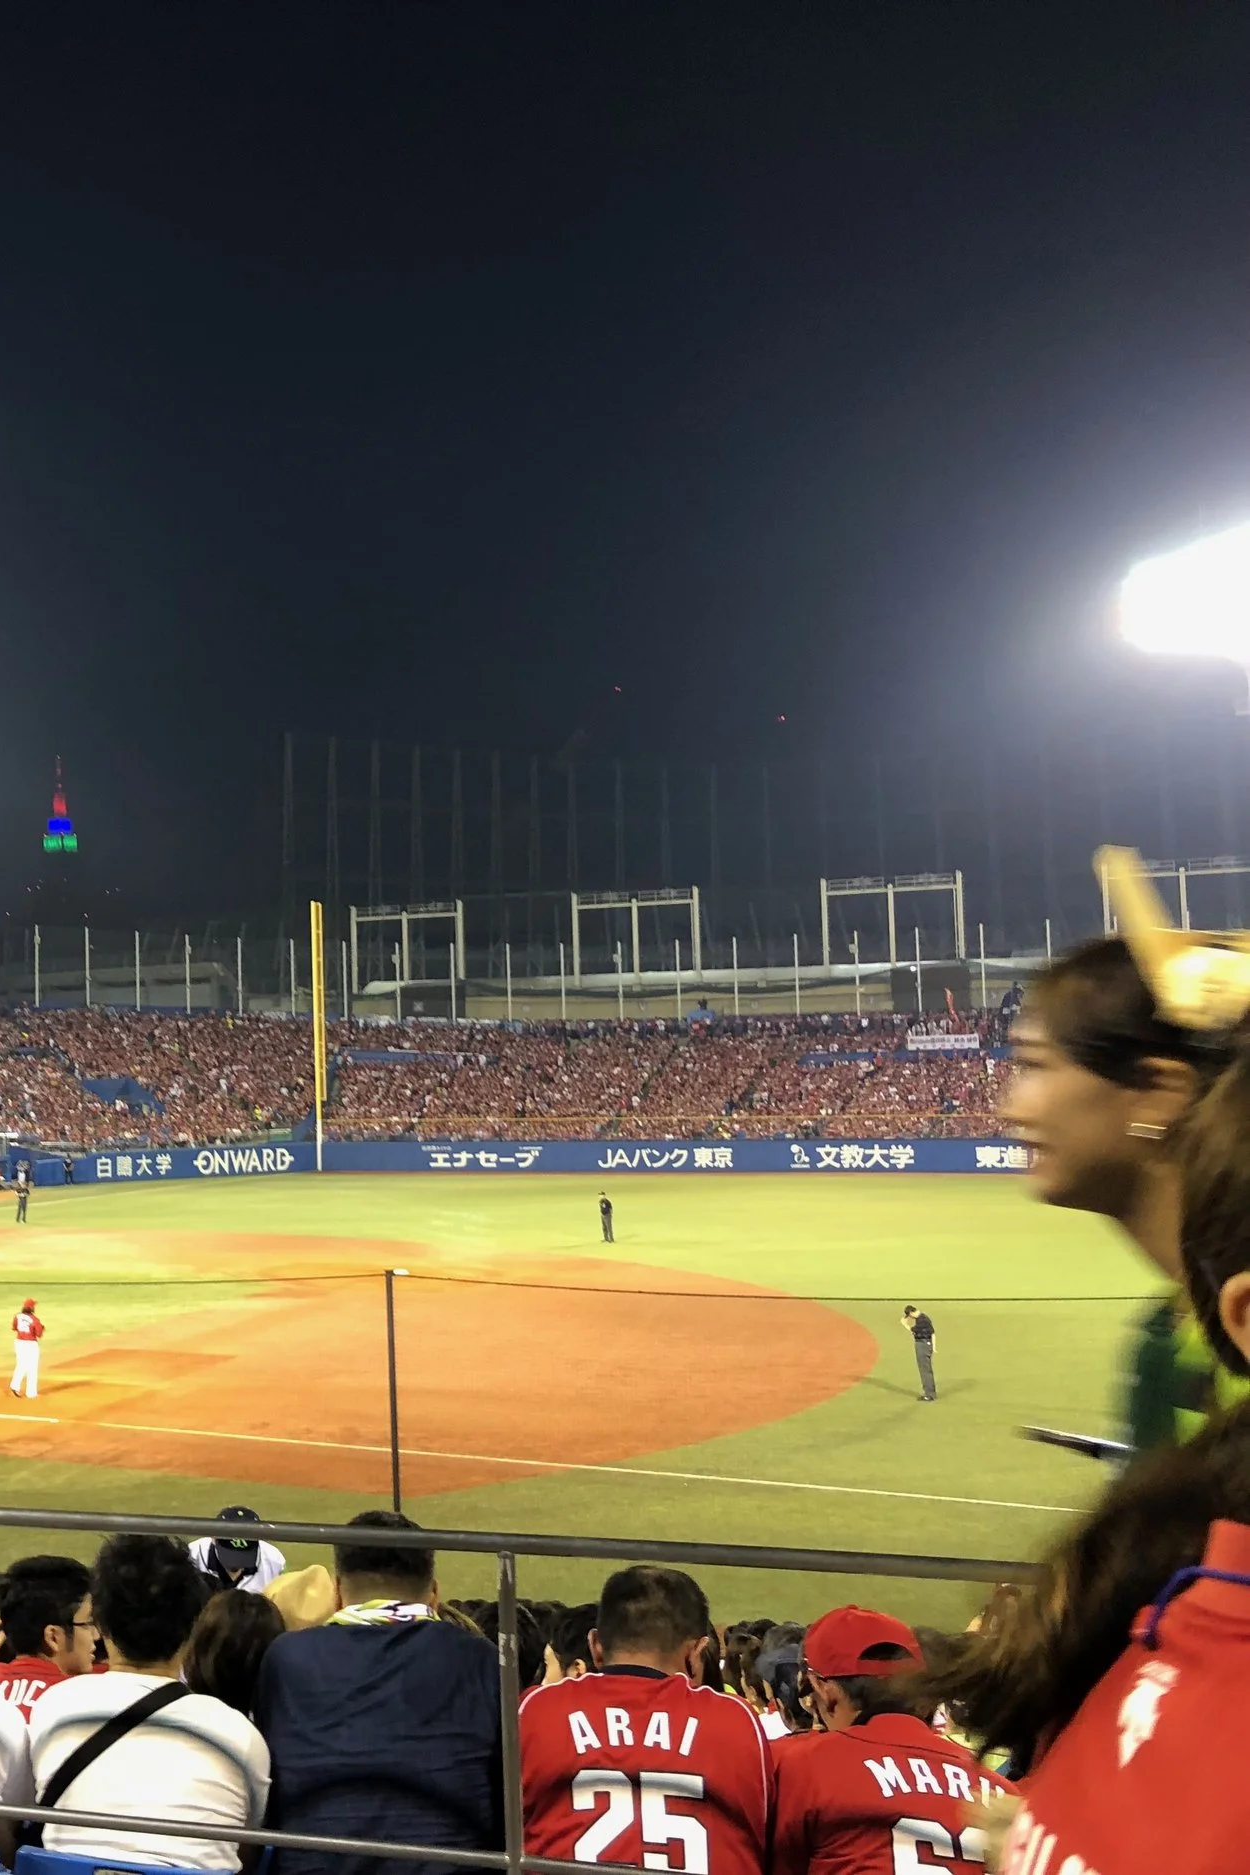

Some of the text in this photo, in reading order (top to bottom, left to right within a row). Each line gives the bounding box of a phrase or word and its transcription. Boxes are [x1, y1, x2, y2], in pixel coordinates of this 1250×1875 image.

[192, 1148, 293, 1175] ONWARD
[429, 1150, 540, 1168] エナセーブ
[598, 1147, 734, 1168] JAバンク 東京
[815, 1144, 915, 1169] 文教大学
[568, 1707, 699, 1757] ARAI
[571, 1769, 709, 1875] 25
